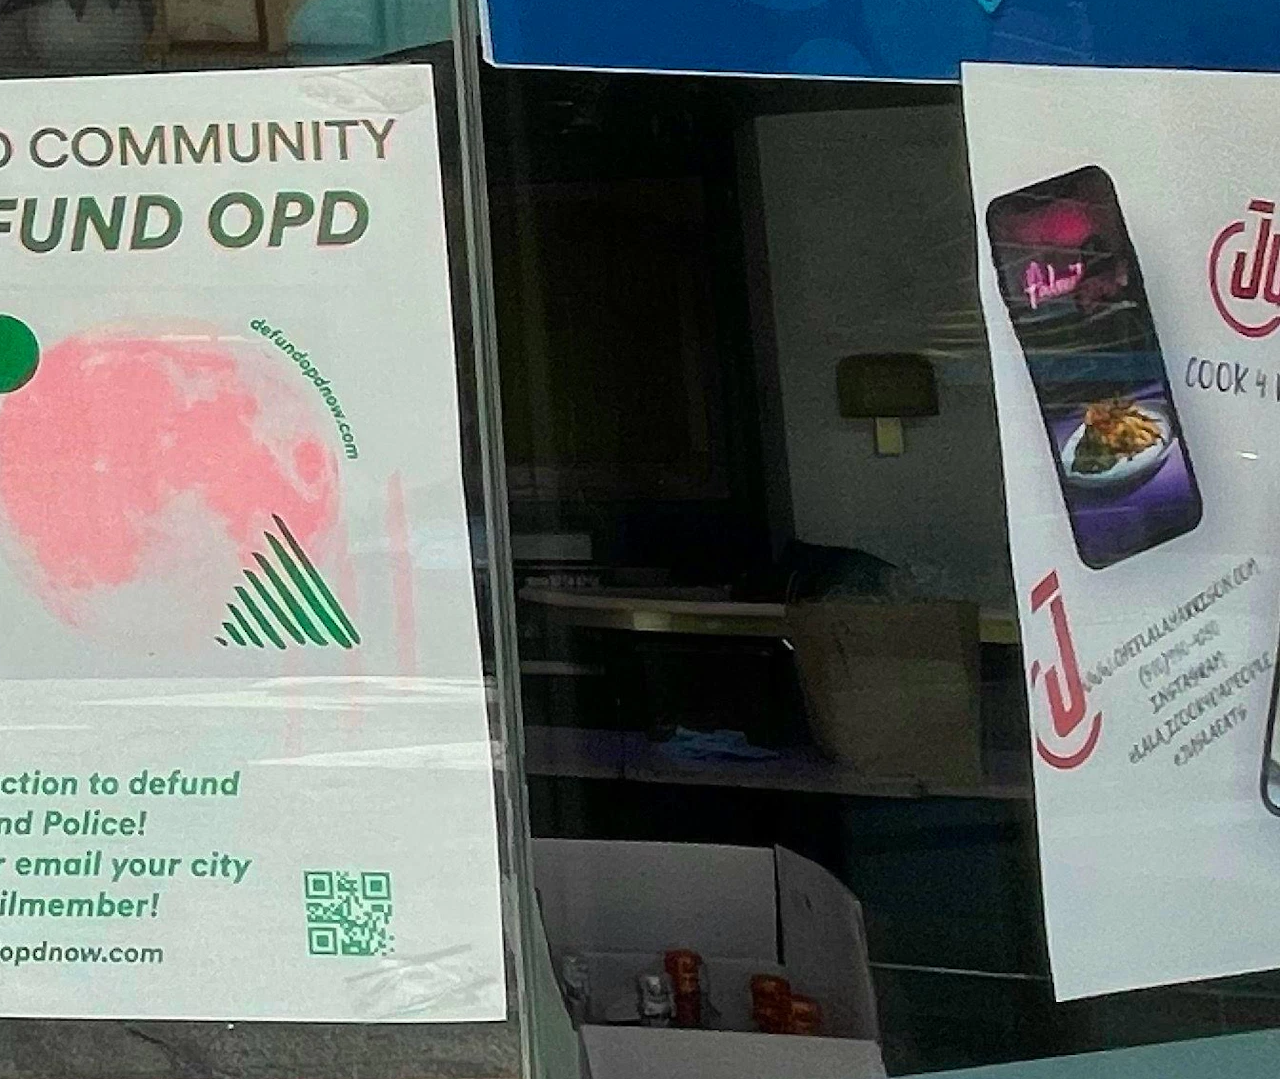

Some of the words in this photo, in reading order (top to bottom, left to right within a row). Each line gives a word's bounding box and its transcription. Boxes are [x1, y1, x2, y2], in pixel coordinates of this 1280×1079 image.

[30, 119, 395, 167] COMMUNITY
[207, 189, 371, 249] OPD
[250, 319, 358, 459] defundopdnow.com
[1186, 356, 1248, 396] COOK
[88, 771, 119, 795] to
[129, 770, 241, 796] defund
[42, 810, 147, 836] Police!
[15, 850, 102, 876] email
[111, 857, 181, 883] your
[190, 850, 253, 884] city
